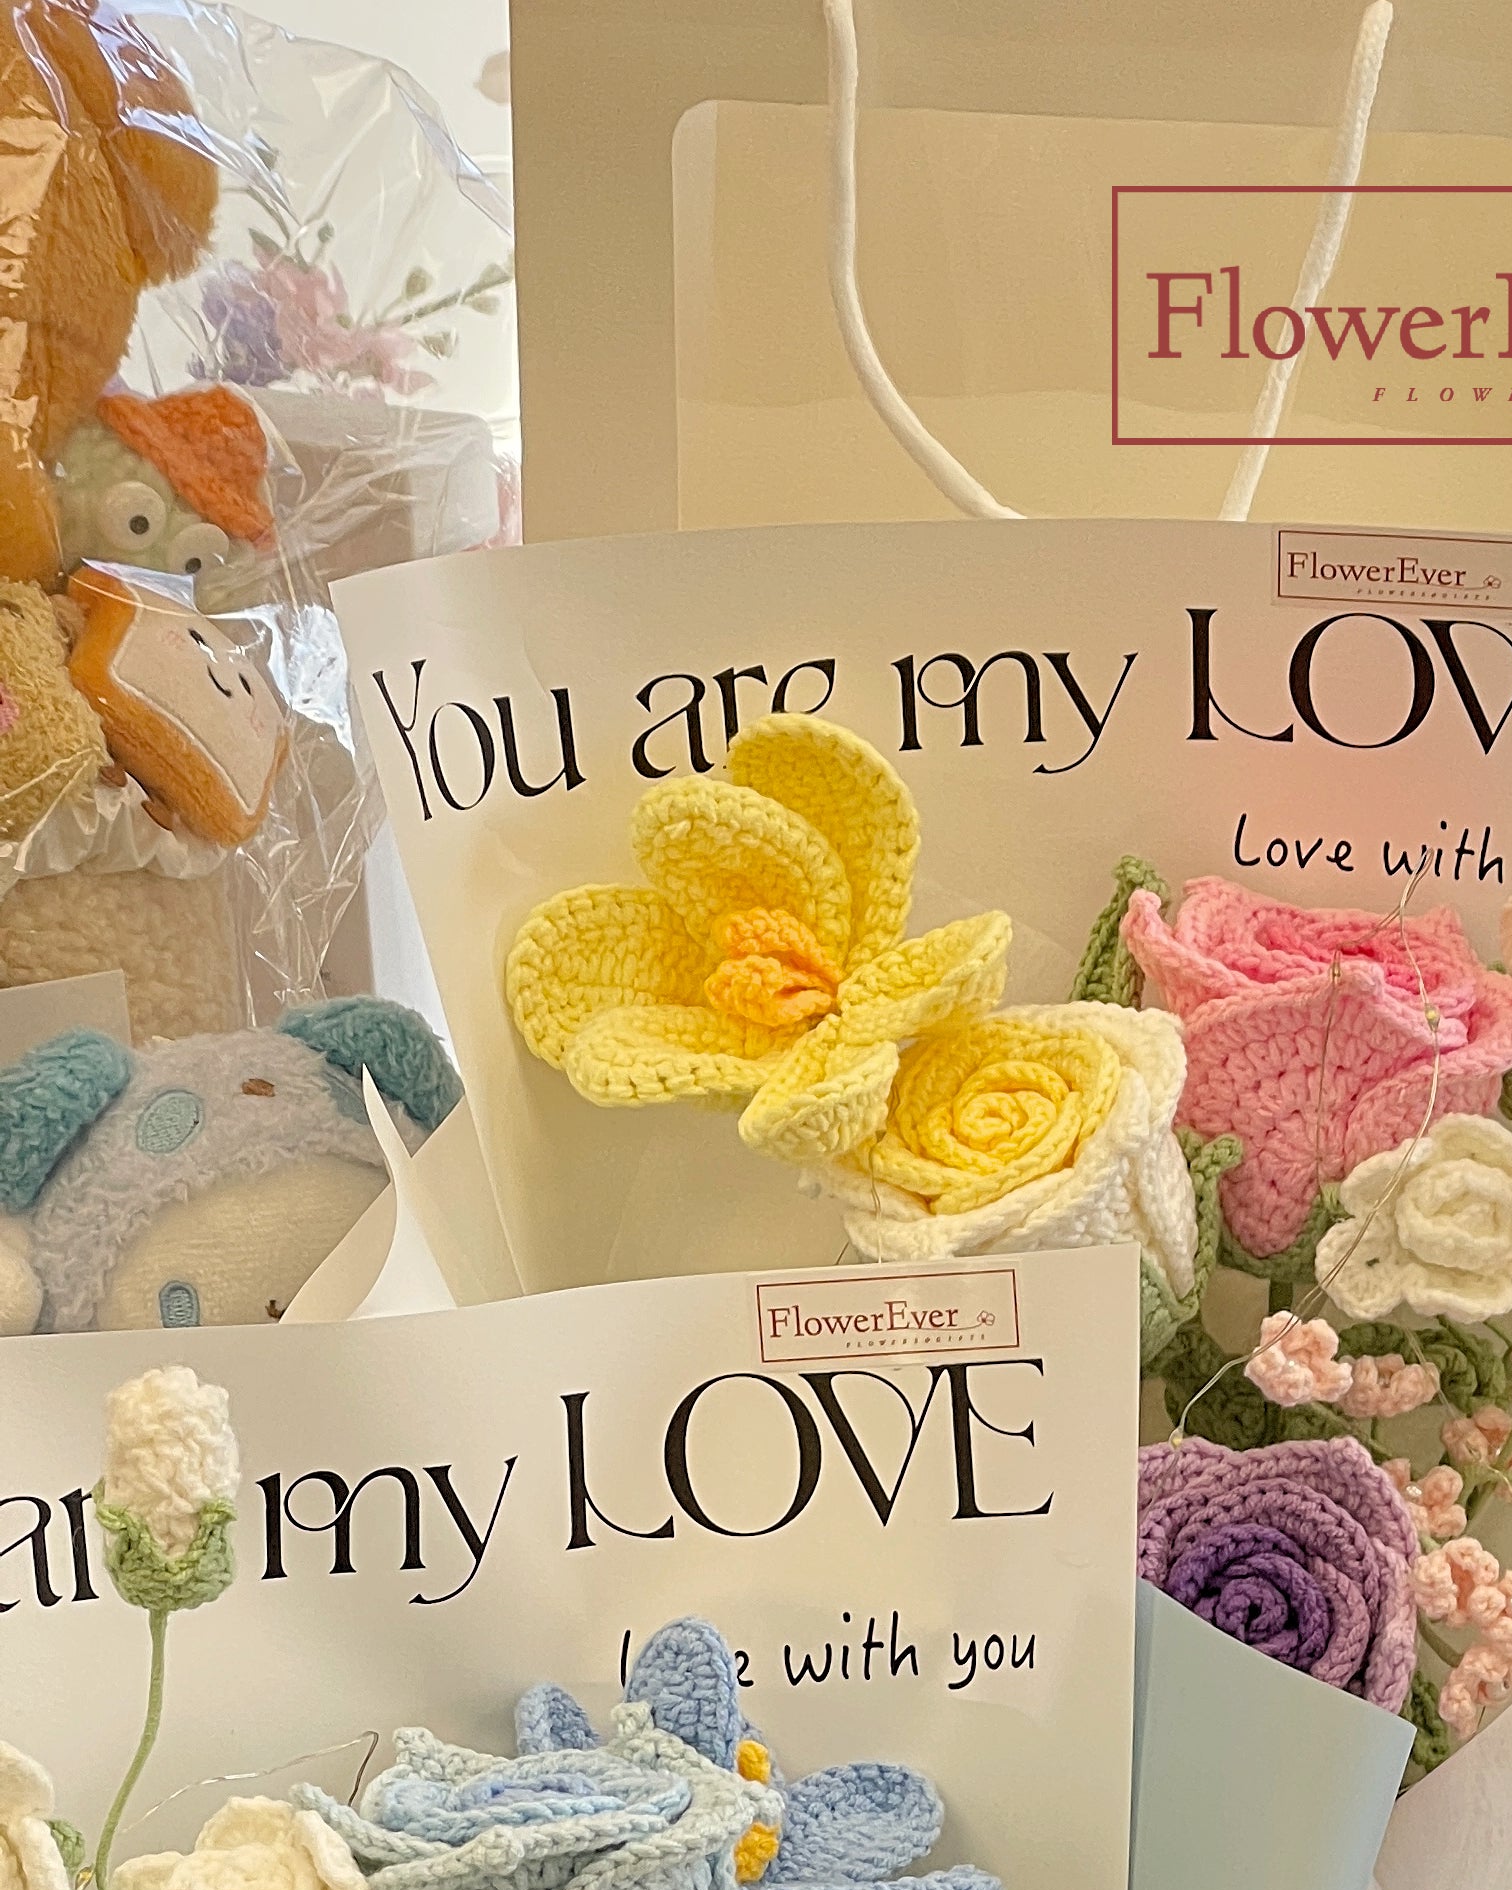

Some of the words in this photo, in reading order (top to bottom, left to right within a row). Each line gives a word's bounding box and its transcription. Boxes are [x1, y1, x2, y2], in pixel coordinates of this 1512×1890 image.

[1286, 551, 1467, 587] FlowerEver
[372, 659, 587, 821] You
[891, 651, 1138, 774] my
[1234, 813, 1355, 872] Love
[1383, 820, 1504, 884] with
[767, 1300, 959, 1339] FlowerEver
[0, 1487, 101, 1614] ar
[255, 1455, 518, 1605] my
[560, 1358, 1054, 1551] LOVE
[784, 1610, 919, 1687] with
[947, 1631, 1037, 1691] you
